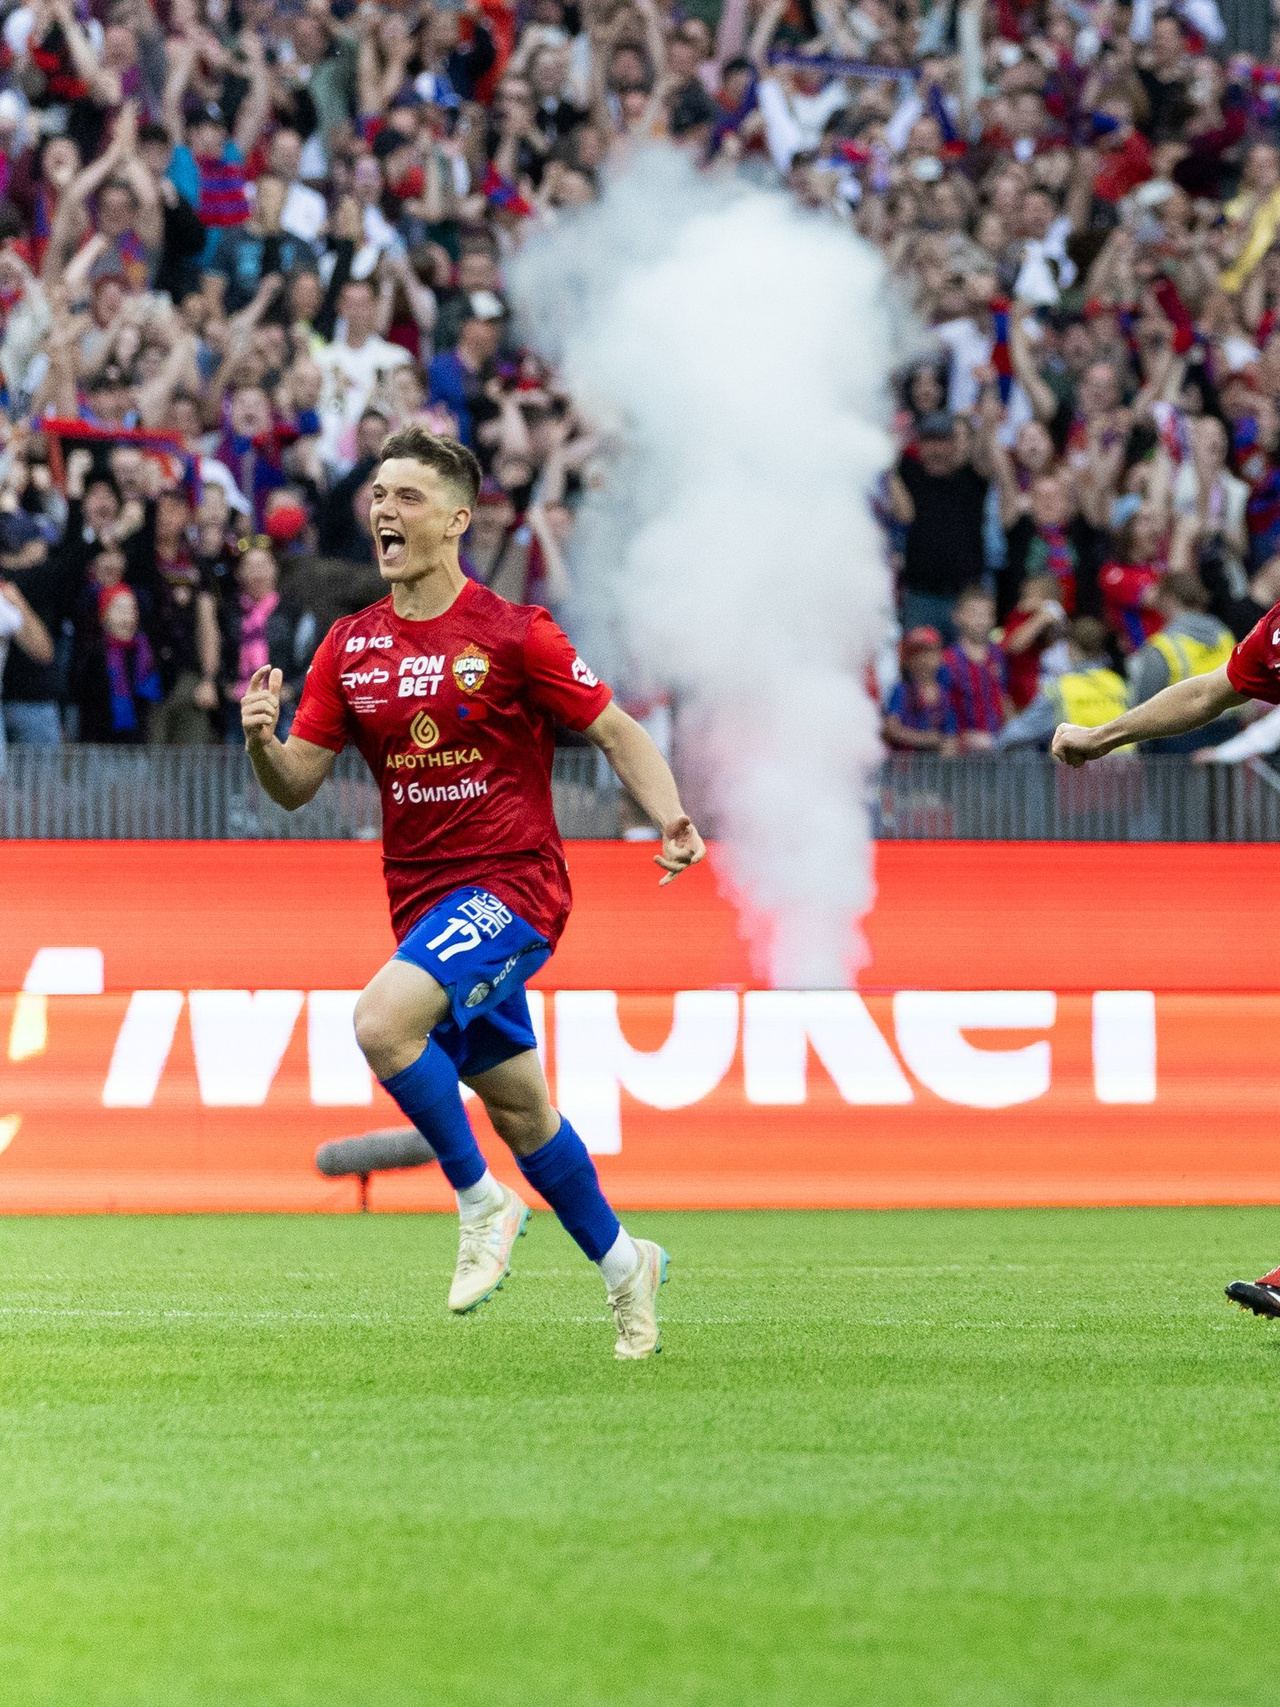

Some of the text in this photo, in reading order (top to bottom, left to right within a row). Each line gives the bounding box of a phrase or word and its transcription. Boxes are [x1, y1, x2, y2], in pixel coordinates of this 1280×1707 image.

[398, 655, 446, 677] FON
[454, 657, 487, 674] ЦСКА
[398, 675, 444, 698] BET
[386, 747, 484, 769] APOTHEKA
[407, 778, 488, 804] билайн
[425, 917, 482, 962] 17
